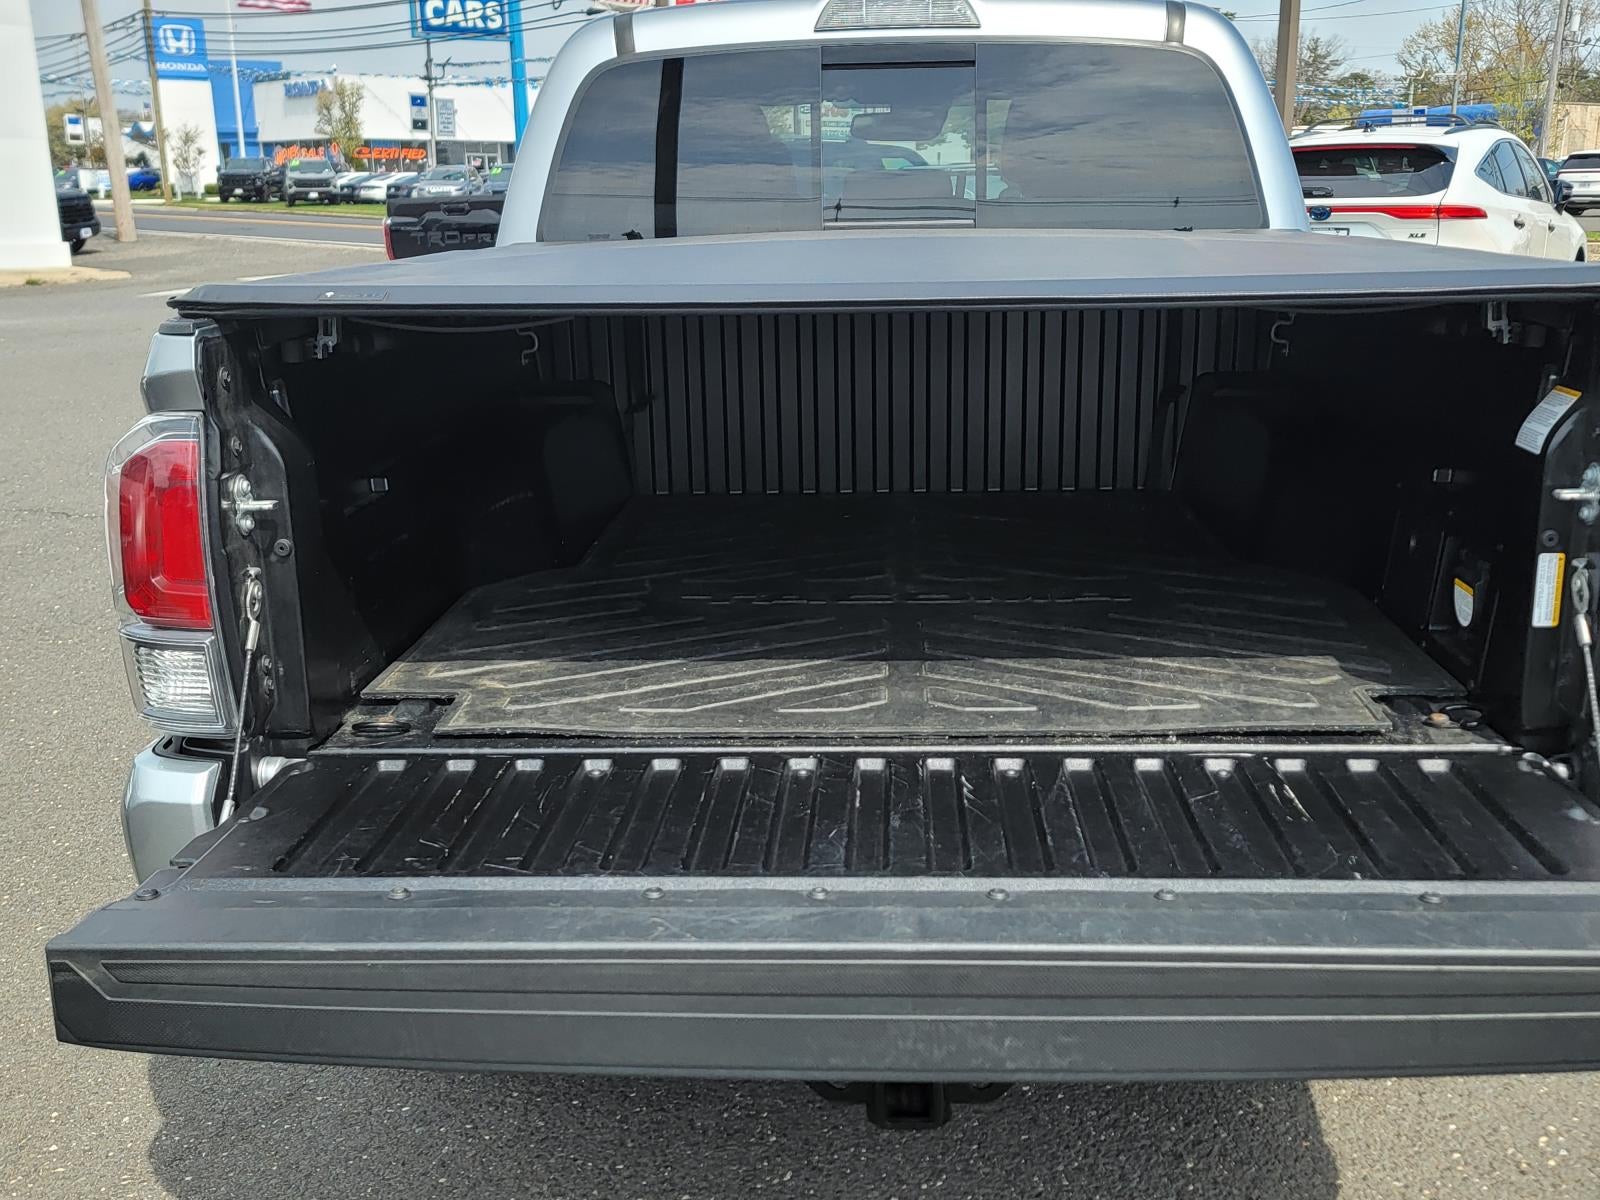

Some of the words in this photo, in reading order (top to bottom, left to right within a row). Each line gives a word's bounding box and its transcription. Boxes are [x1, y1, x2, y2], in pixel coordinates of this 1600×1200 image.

[425, 0, 503, 29] CARS
[156, 62, 207, 72] HONDA
[353, 146, 427, 160] CERTIFIED
[463, 232, 498, 244] PR
